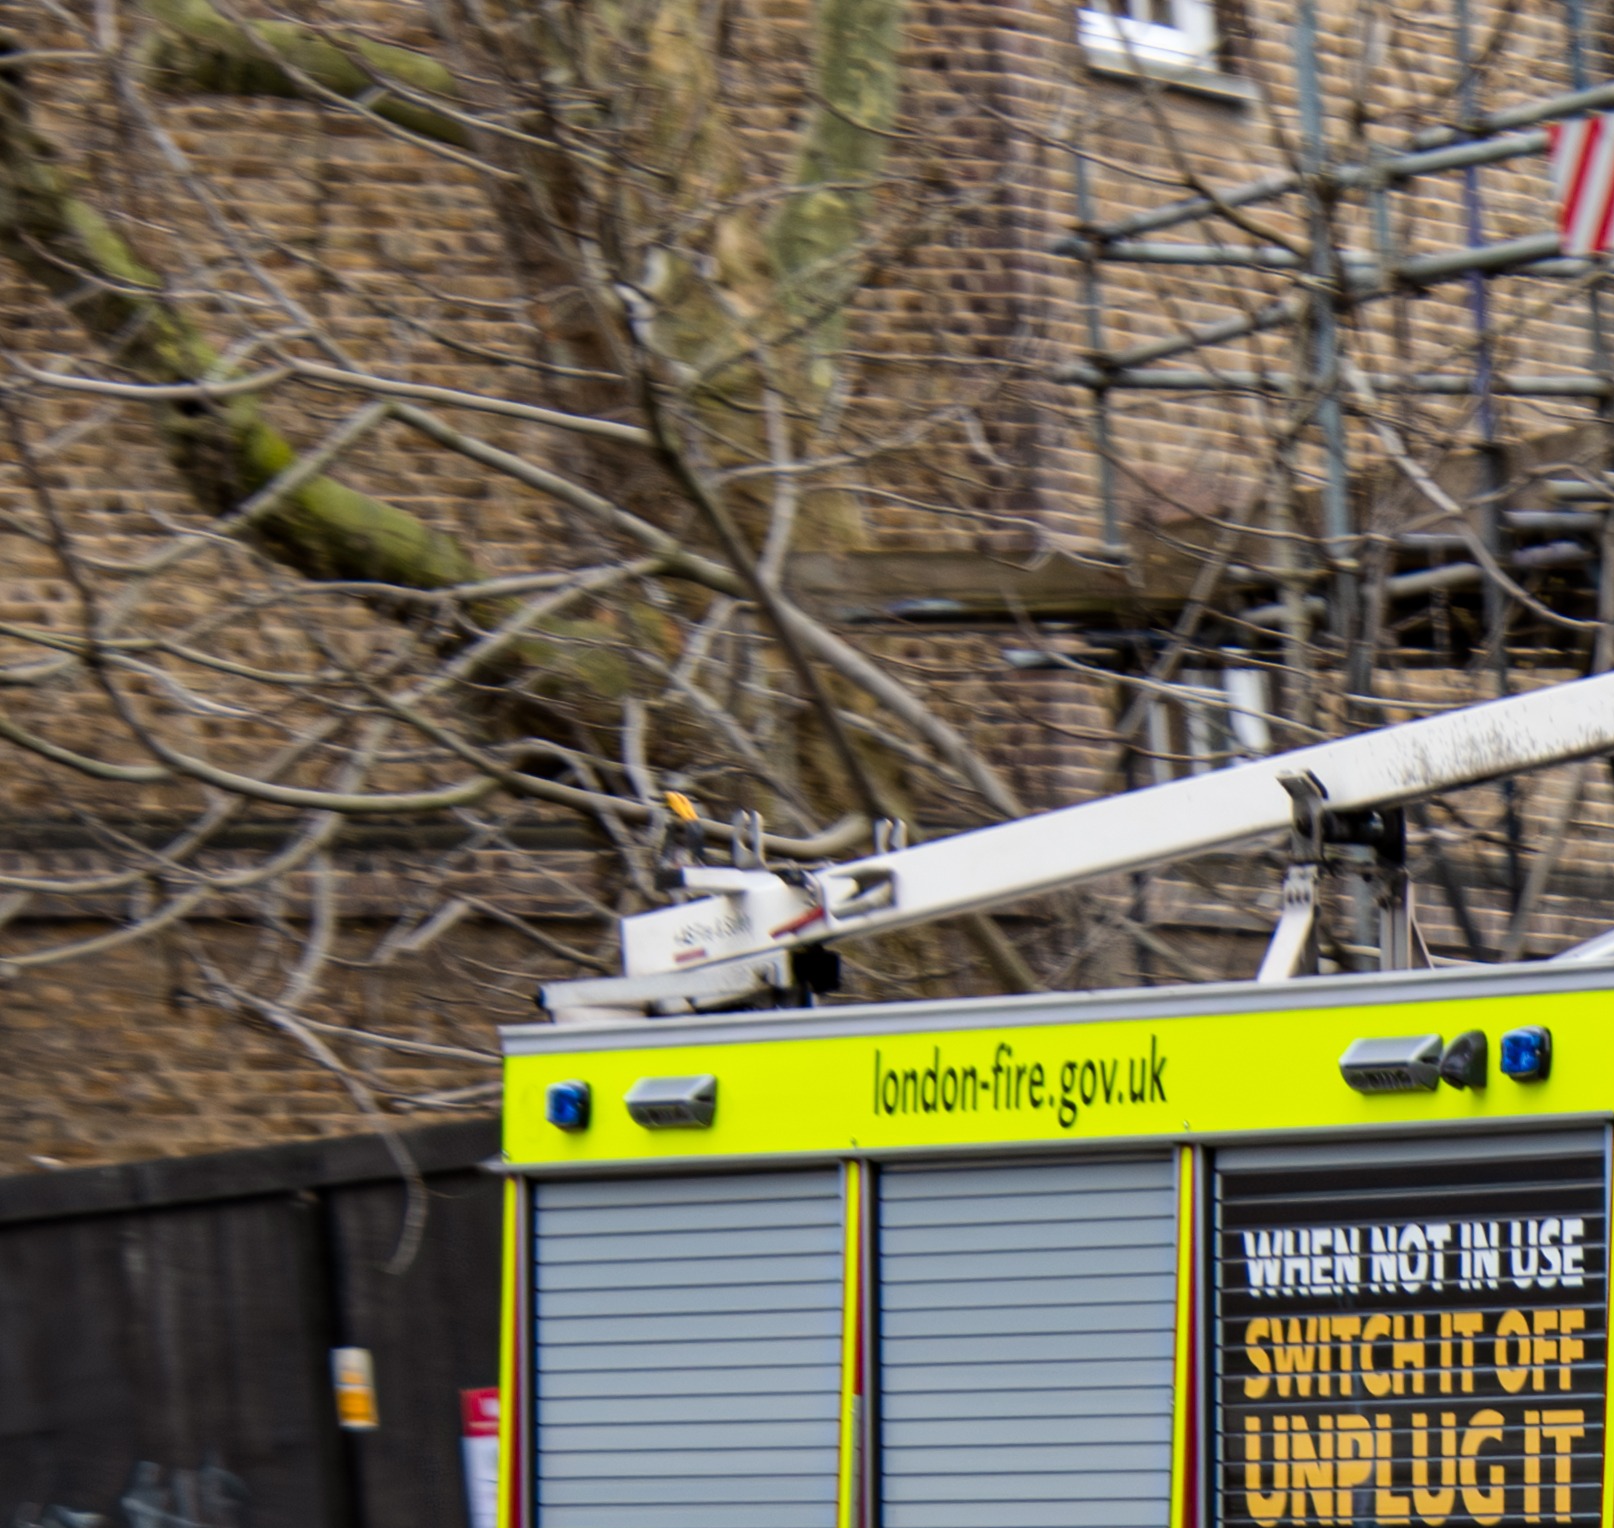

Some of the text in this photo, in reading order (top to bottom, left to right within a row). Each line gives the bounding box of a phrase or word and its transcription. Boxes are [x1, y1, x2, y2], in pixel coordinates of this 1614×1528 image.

[873, 1034, 1167, 1129] london-fire.gov.uk
[1243, 1217, 1585, 1297] WHEN NOT IN USE
[1243, 1308, 1585, 1399] SWITCH IT OFF
[1243, 1408, 1586, 1528] UNPLUG IT
